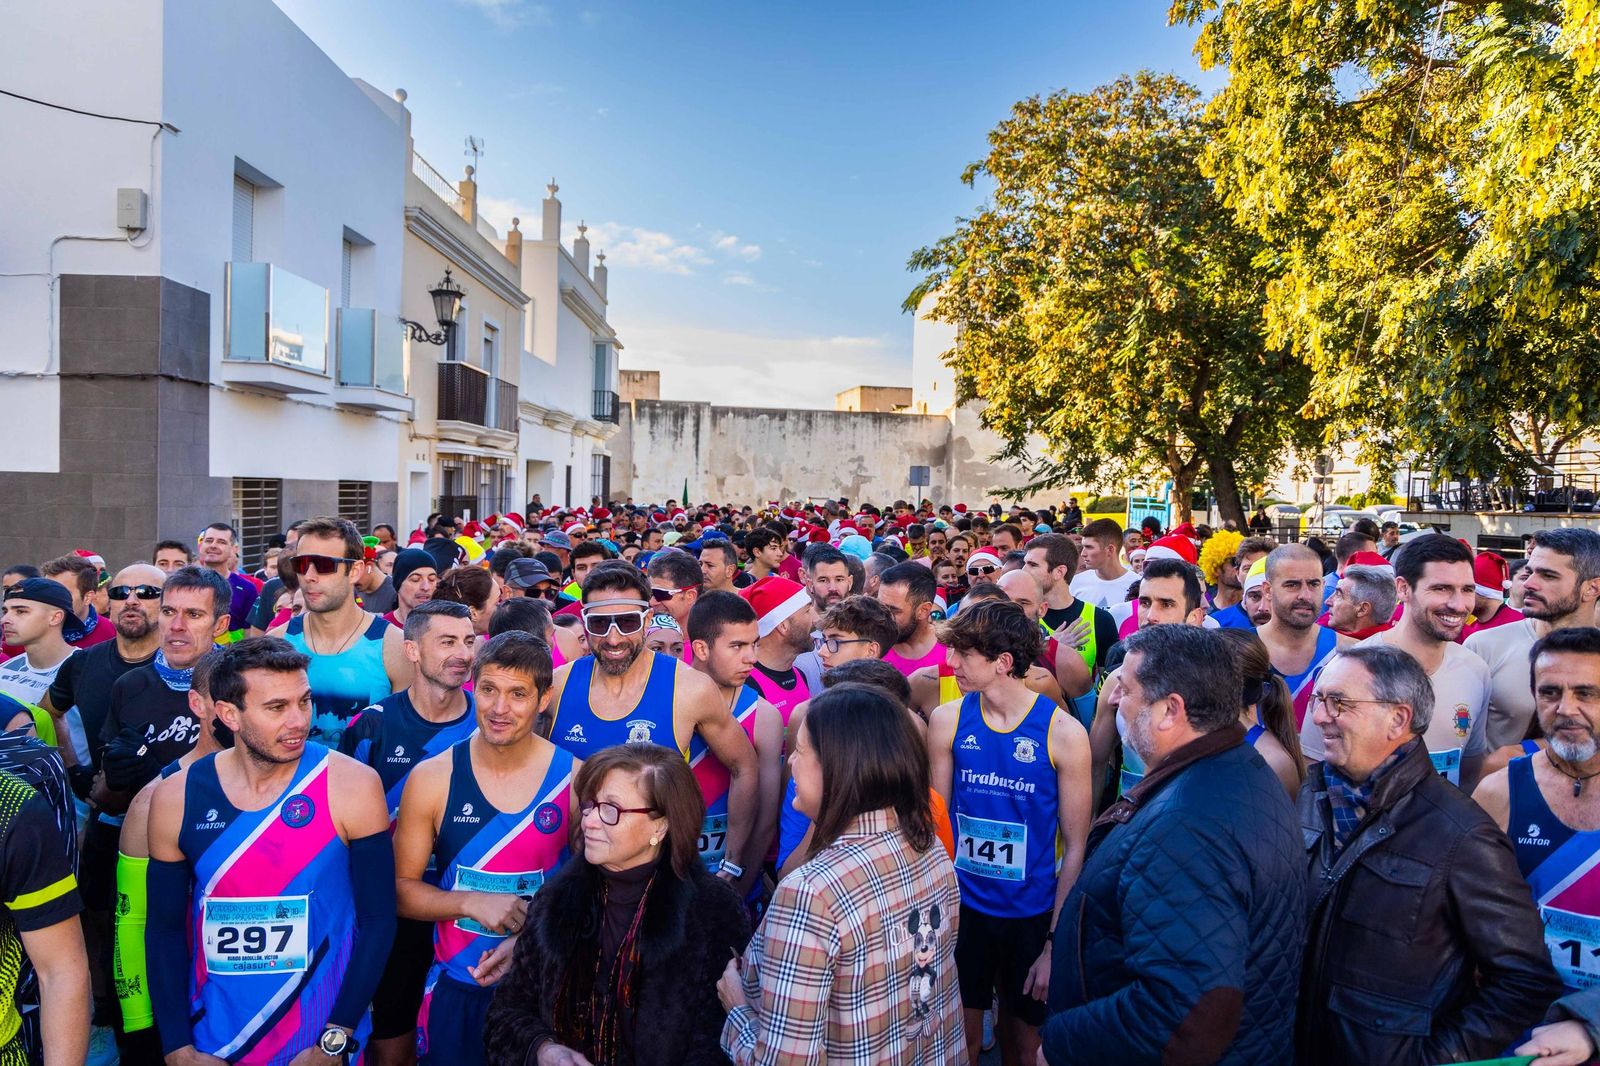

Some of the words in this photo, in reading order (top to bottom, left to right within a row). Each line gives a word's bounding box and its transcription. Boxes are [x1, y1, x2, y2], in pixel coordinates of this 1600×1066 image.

[960, 768, 1036, 794] Tirabuzón
[453, 815, 480, 823] VIATOR
[196, 821, 226, 830] VIATOR
[1518, 837, 1550, 846] VIATOR
[964, 836, 1014, 865] 141
[217, 924, 294, 954] 297
[233, 962, 269, 971] cajasur
